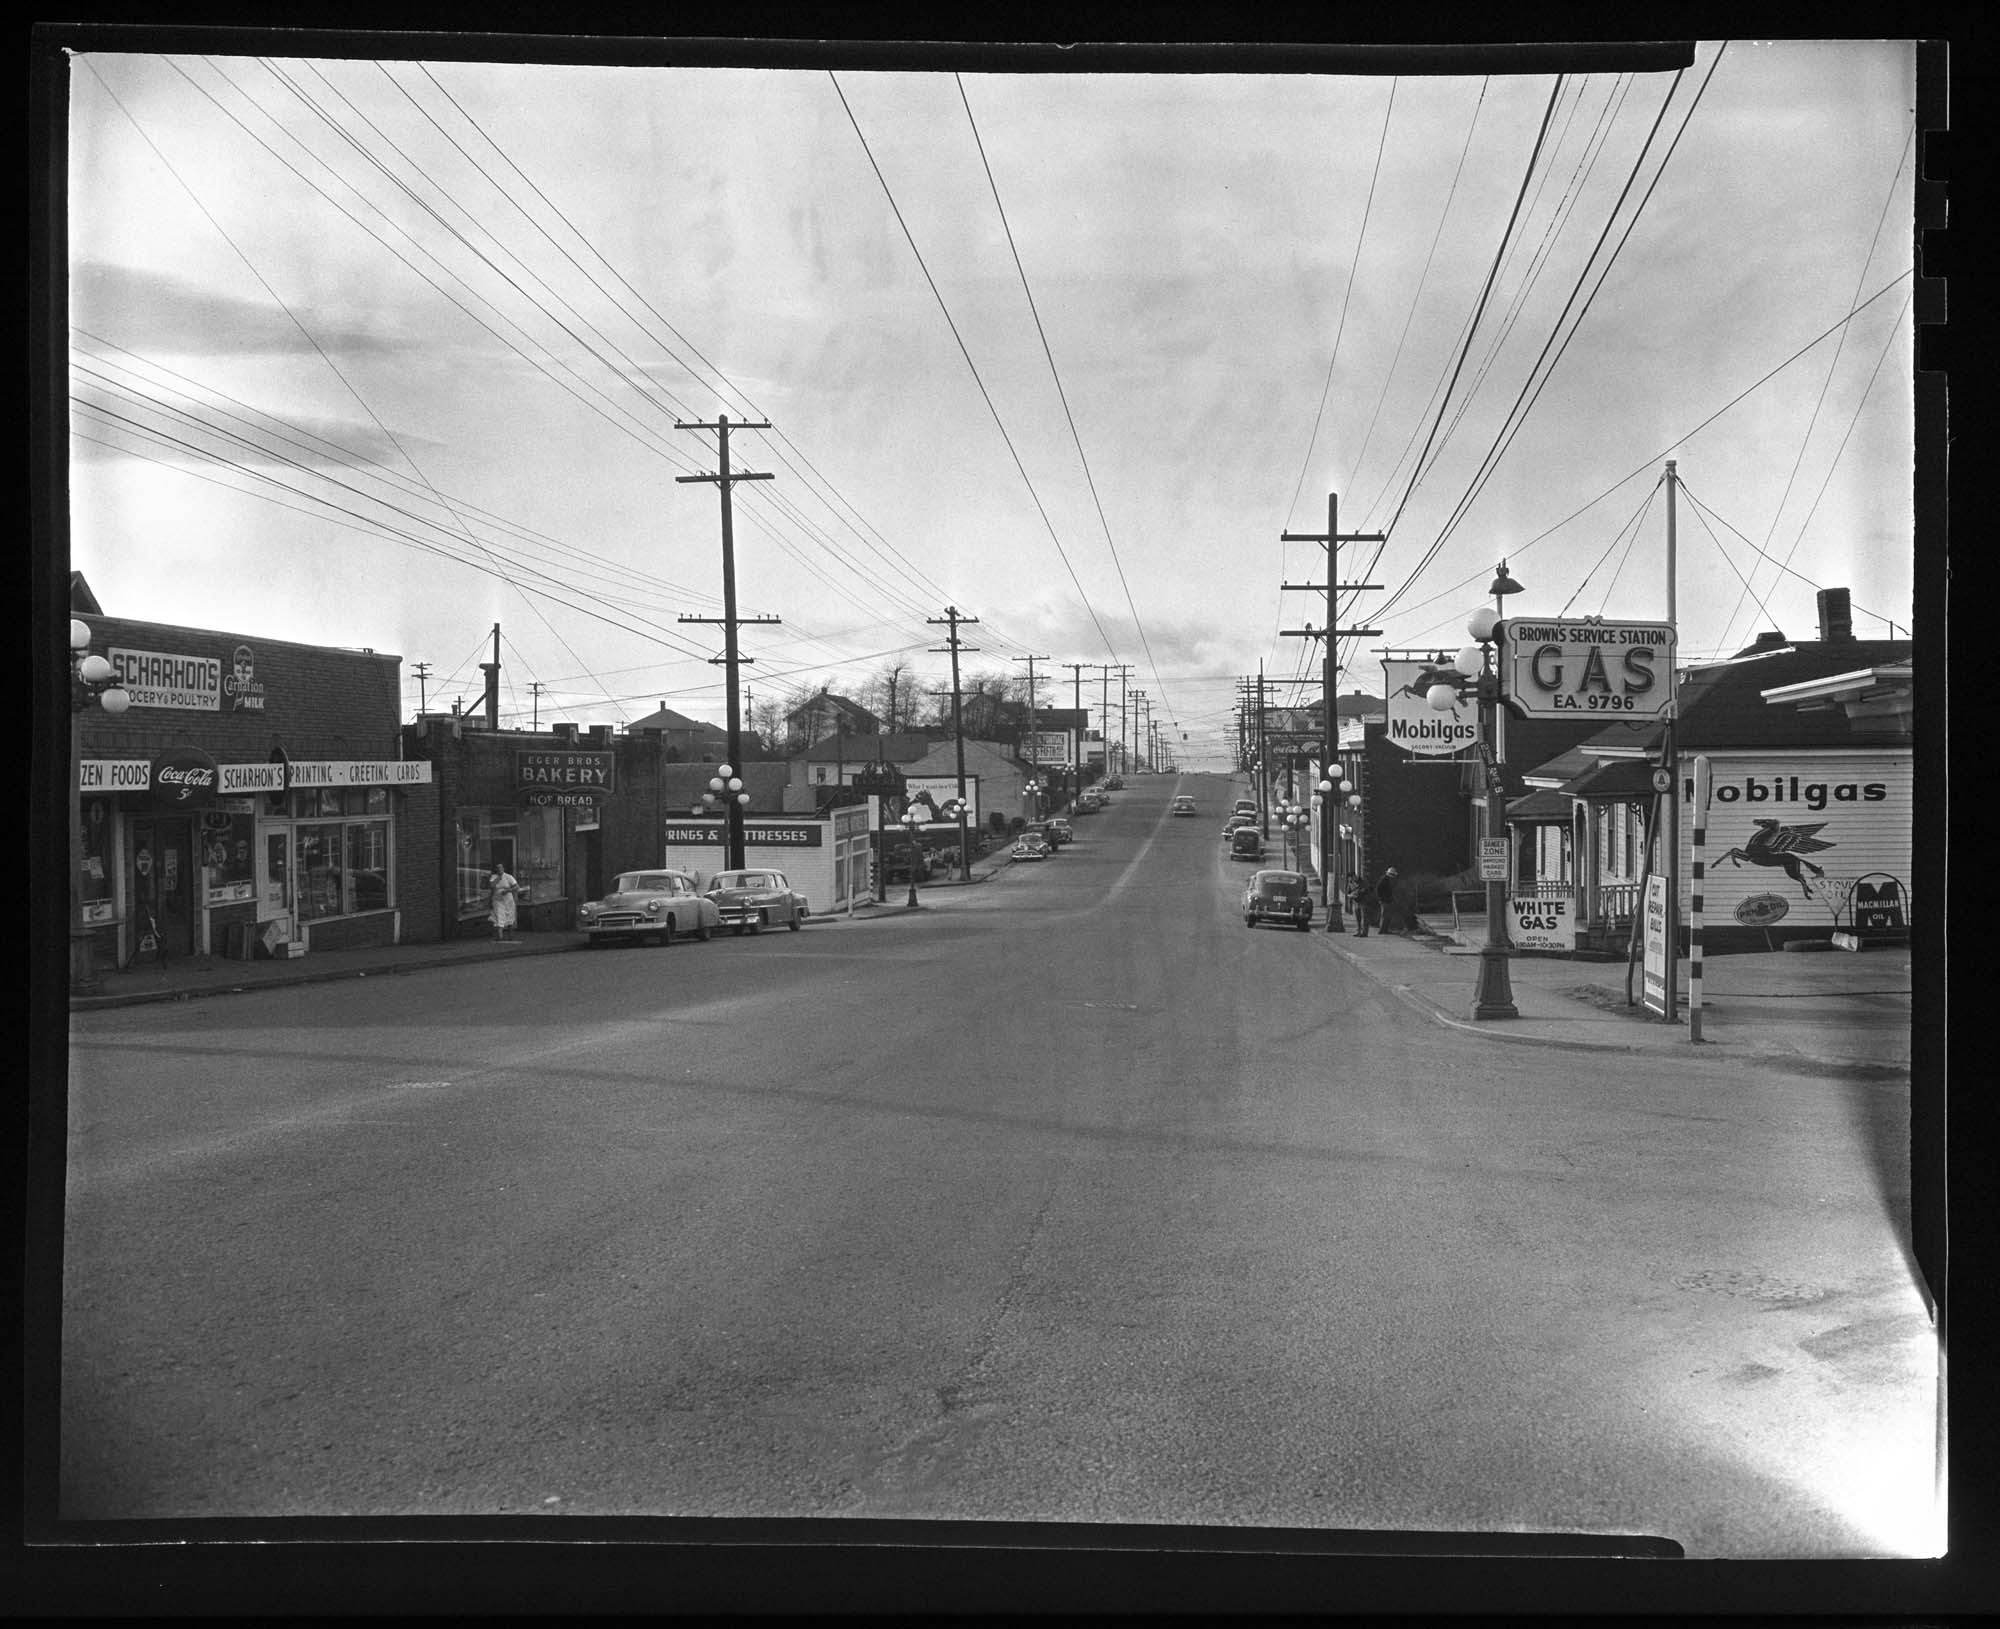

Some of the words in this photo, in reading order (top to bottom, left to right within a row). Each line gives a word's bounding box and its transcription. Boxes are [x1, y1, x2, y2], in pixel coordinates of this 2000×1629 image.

[1570, 628, 1616, 644] SERVICE
[1619, 630, 1666, 645] STATION
[113, 653, 218, 692] SCHARHON'S
[1531, 644, 1656, 693] GAS
[224, 674, 264, 696] Carnation
[171, 693, 217, 707] POULTRY
[244, 696, 265, 709] MILK
[1553, 694, 1582, 709] EA.
[1588, 695, 1634, 710] 9796
[1392, 719, 1475, 744] Mobilgas
[111, 764, 149, 786] FOODS
[158, 766, 214, 787] Coca-Cola
[224, 767, 283, 789] SCHARHON'S
[289, 765, 333, 783] PRINTING
[350, 765, 389, 783] GREETING
[397, 764, 420, 780] CARDS
[522, 767, 608, 784] BAKERY
[1494, 785, 1504, 793] S
[557, 795, 593, 806] BREAD
[708, 830, 719, 840] &
[1513, 901, 1566, 915] WHITE
[1858, 900, 1899, 909] MACMILLAN
[1520, 915, 1558, 930] GAS
